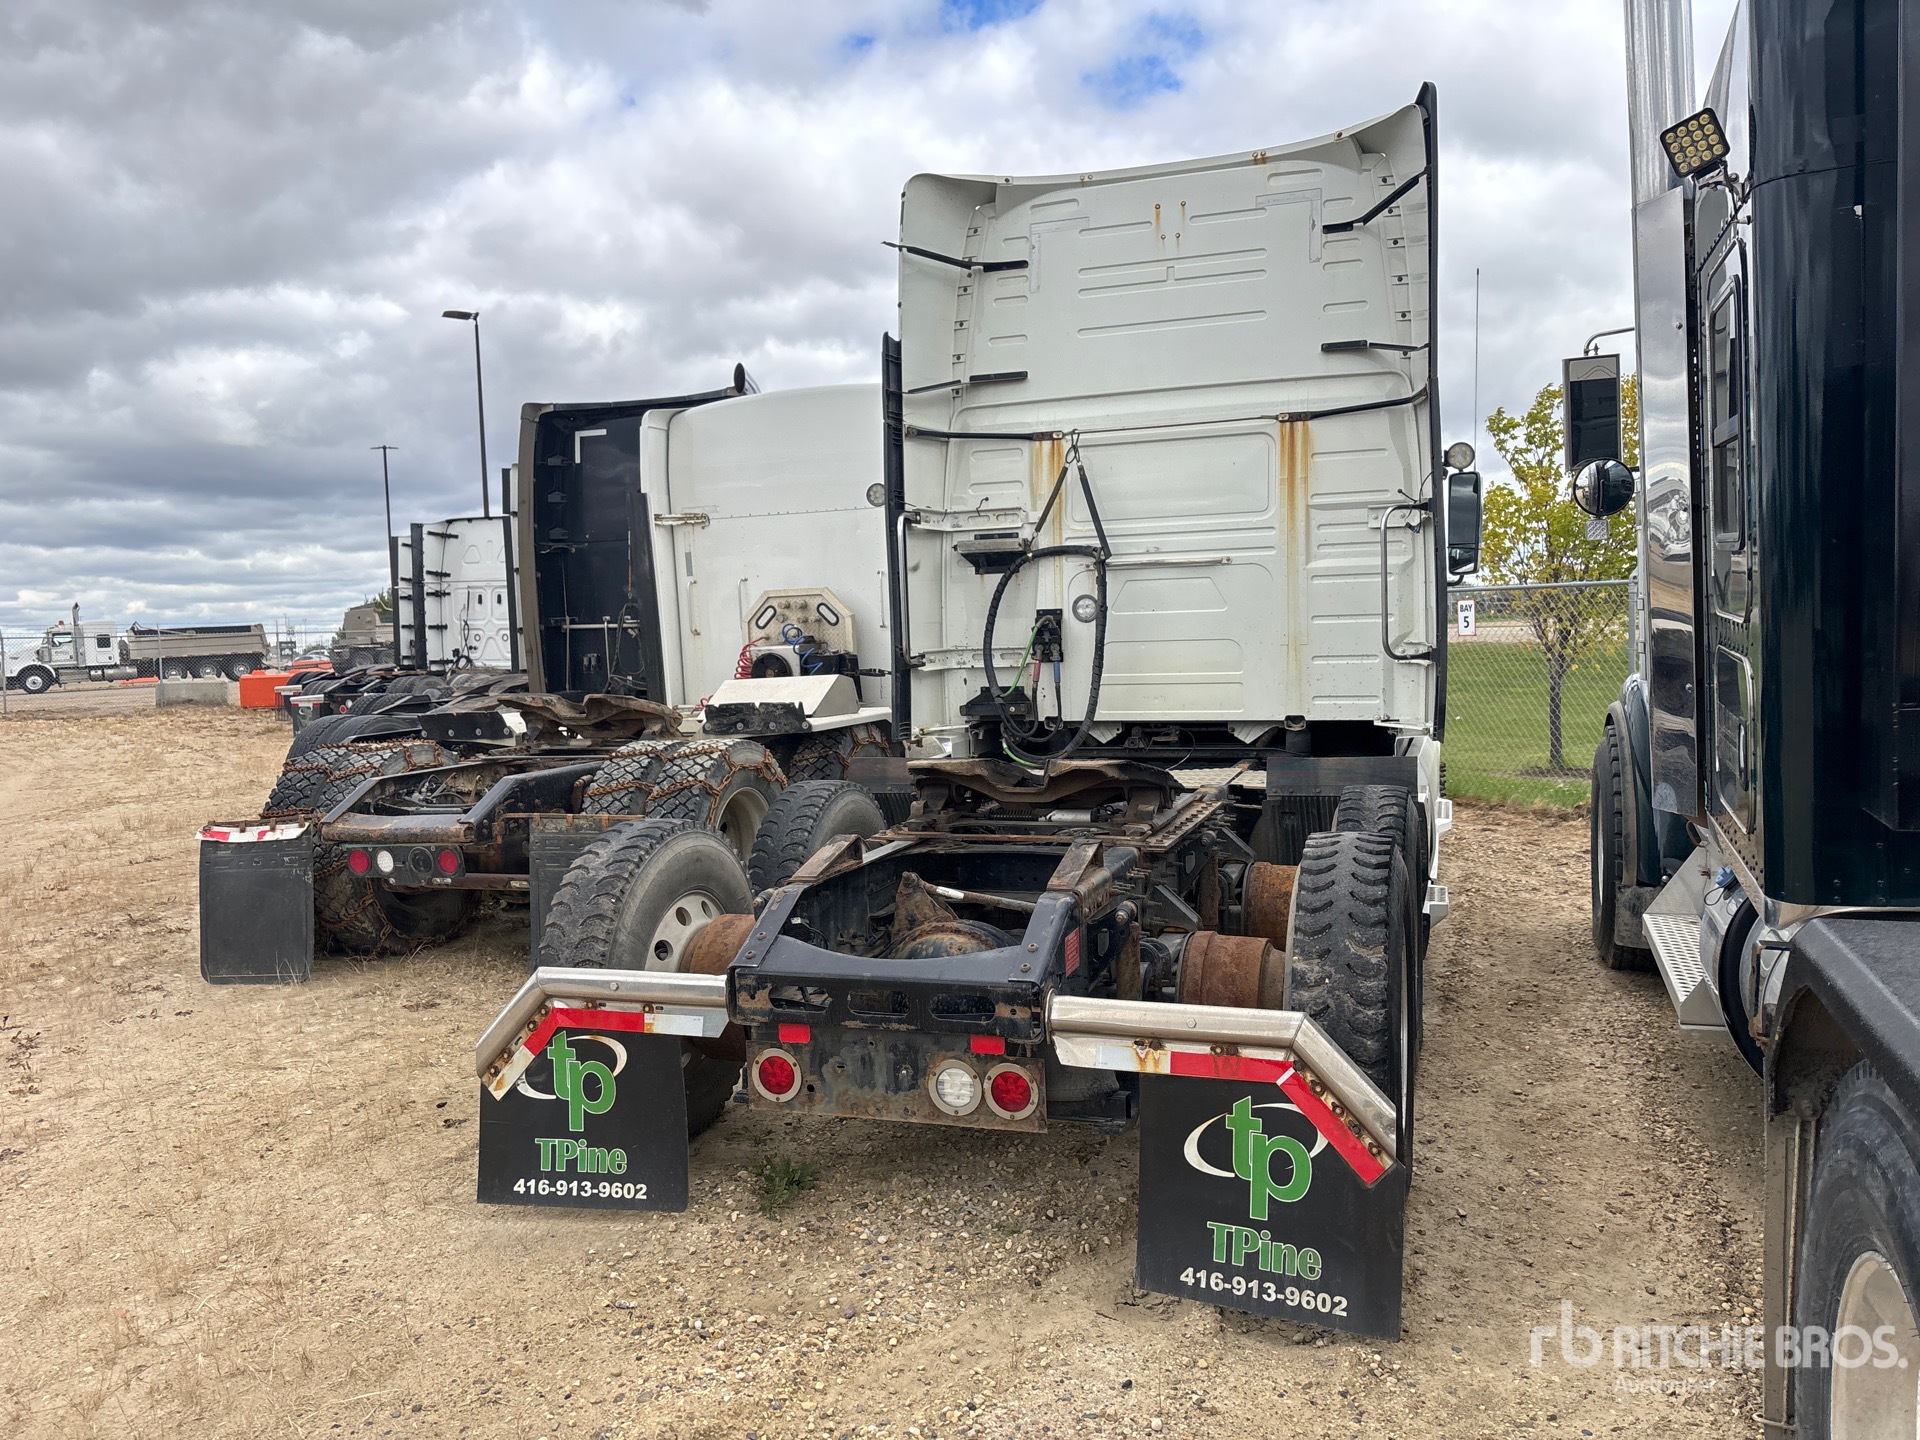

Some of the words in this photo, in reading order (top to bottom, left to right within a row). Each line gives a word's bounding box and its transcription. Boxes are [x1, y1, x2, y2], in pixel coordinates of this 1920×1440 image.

[1460, 604, 1473, 612] BAY
[1463, 616, 1470, 629] 5
[547, 1030, 617, 1132] tp
[534, 1137, 628, 1175] TPine
[1225, 1095, 1313, 1221] tp
[512, 1178, 648, 1200] 416-913-9602
[1206, 1220, 1322, 1281] TPine
[1179, 1266, 1349, 1317] 416-913-9602
